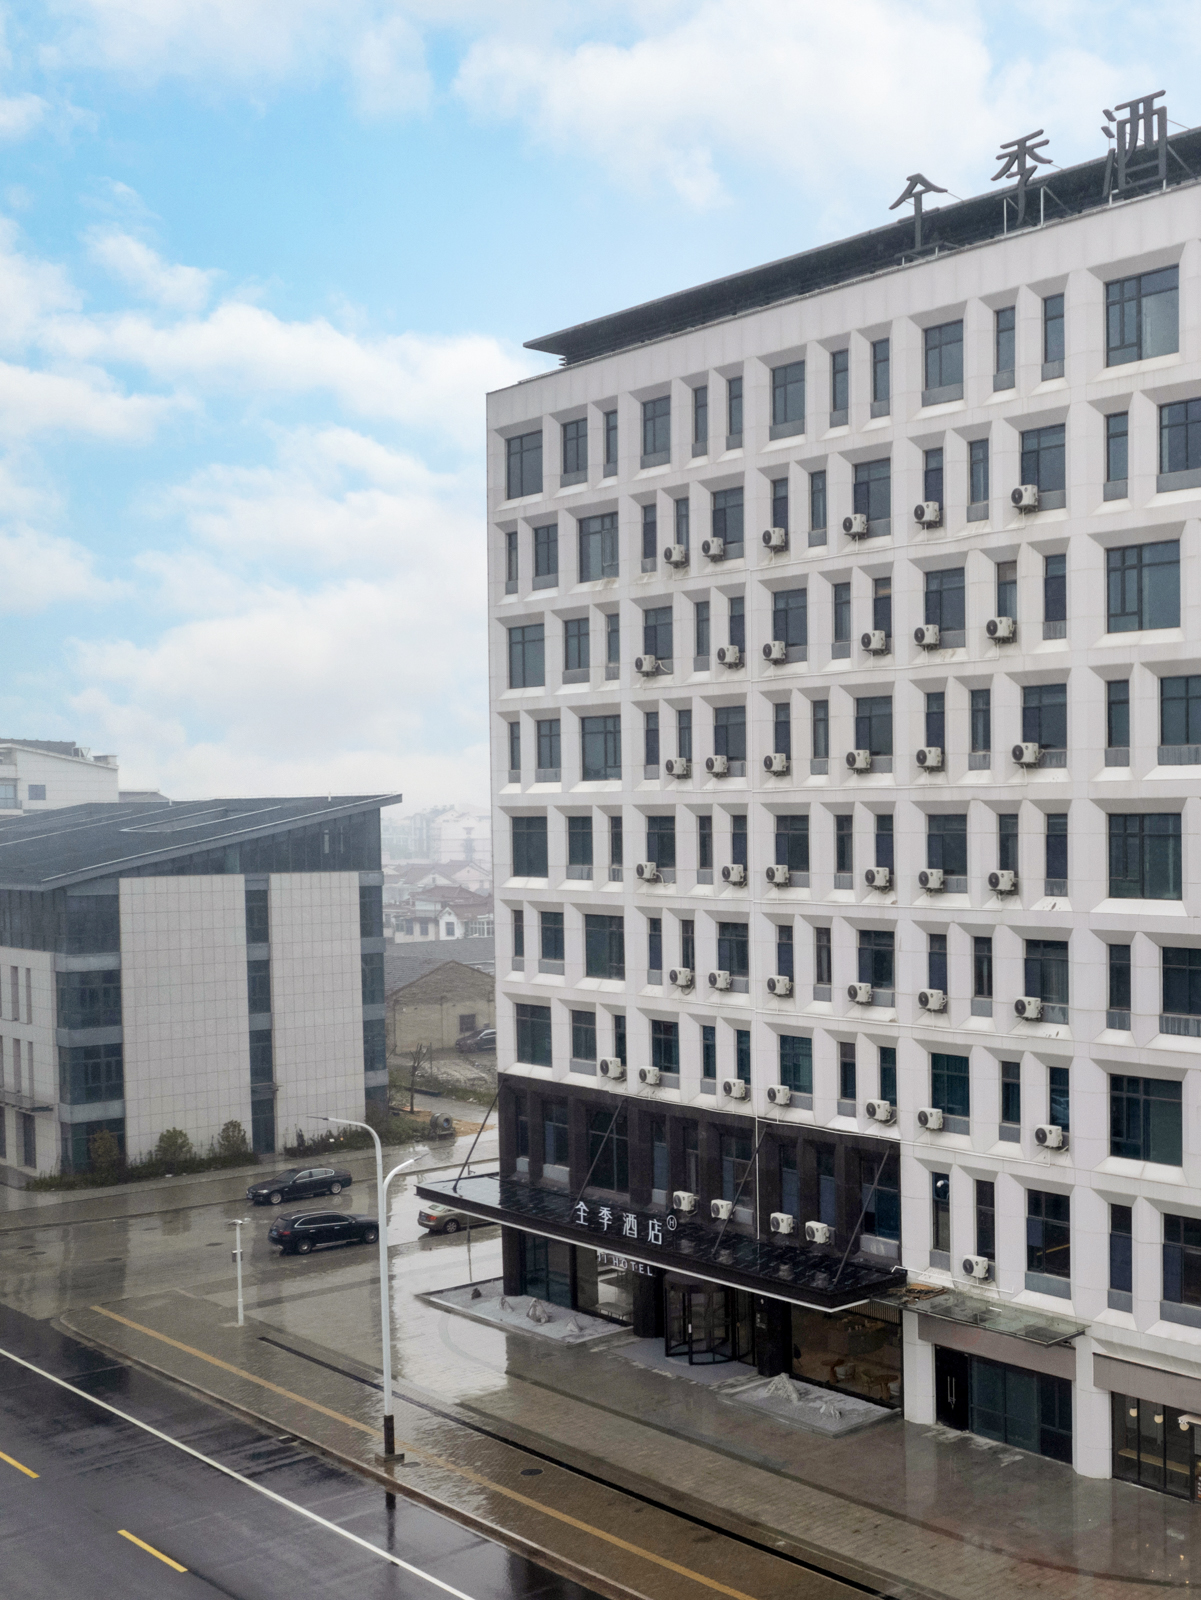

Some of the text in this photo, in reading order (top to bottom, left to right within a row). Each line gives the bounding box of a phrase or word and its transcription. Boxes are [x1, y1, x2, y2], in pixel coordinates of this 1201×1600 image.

[575, 1201, 662, 1245] 全季酒店
[612, 1256, 652, 1276] HOTEL
